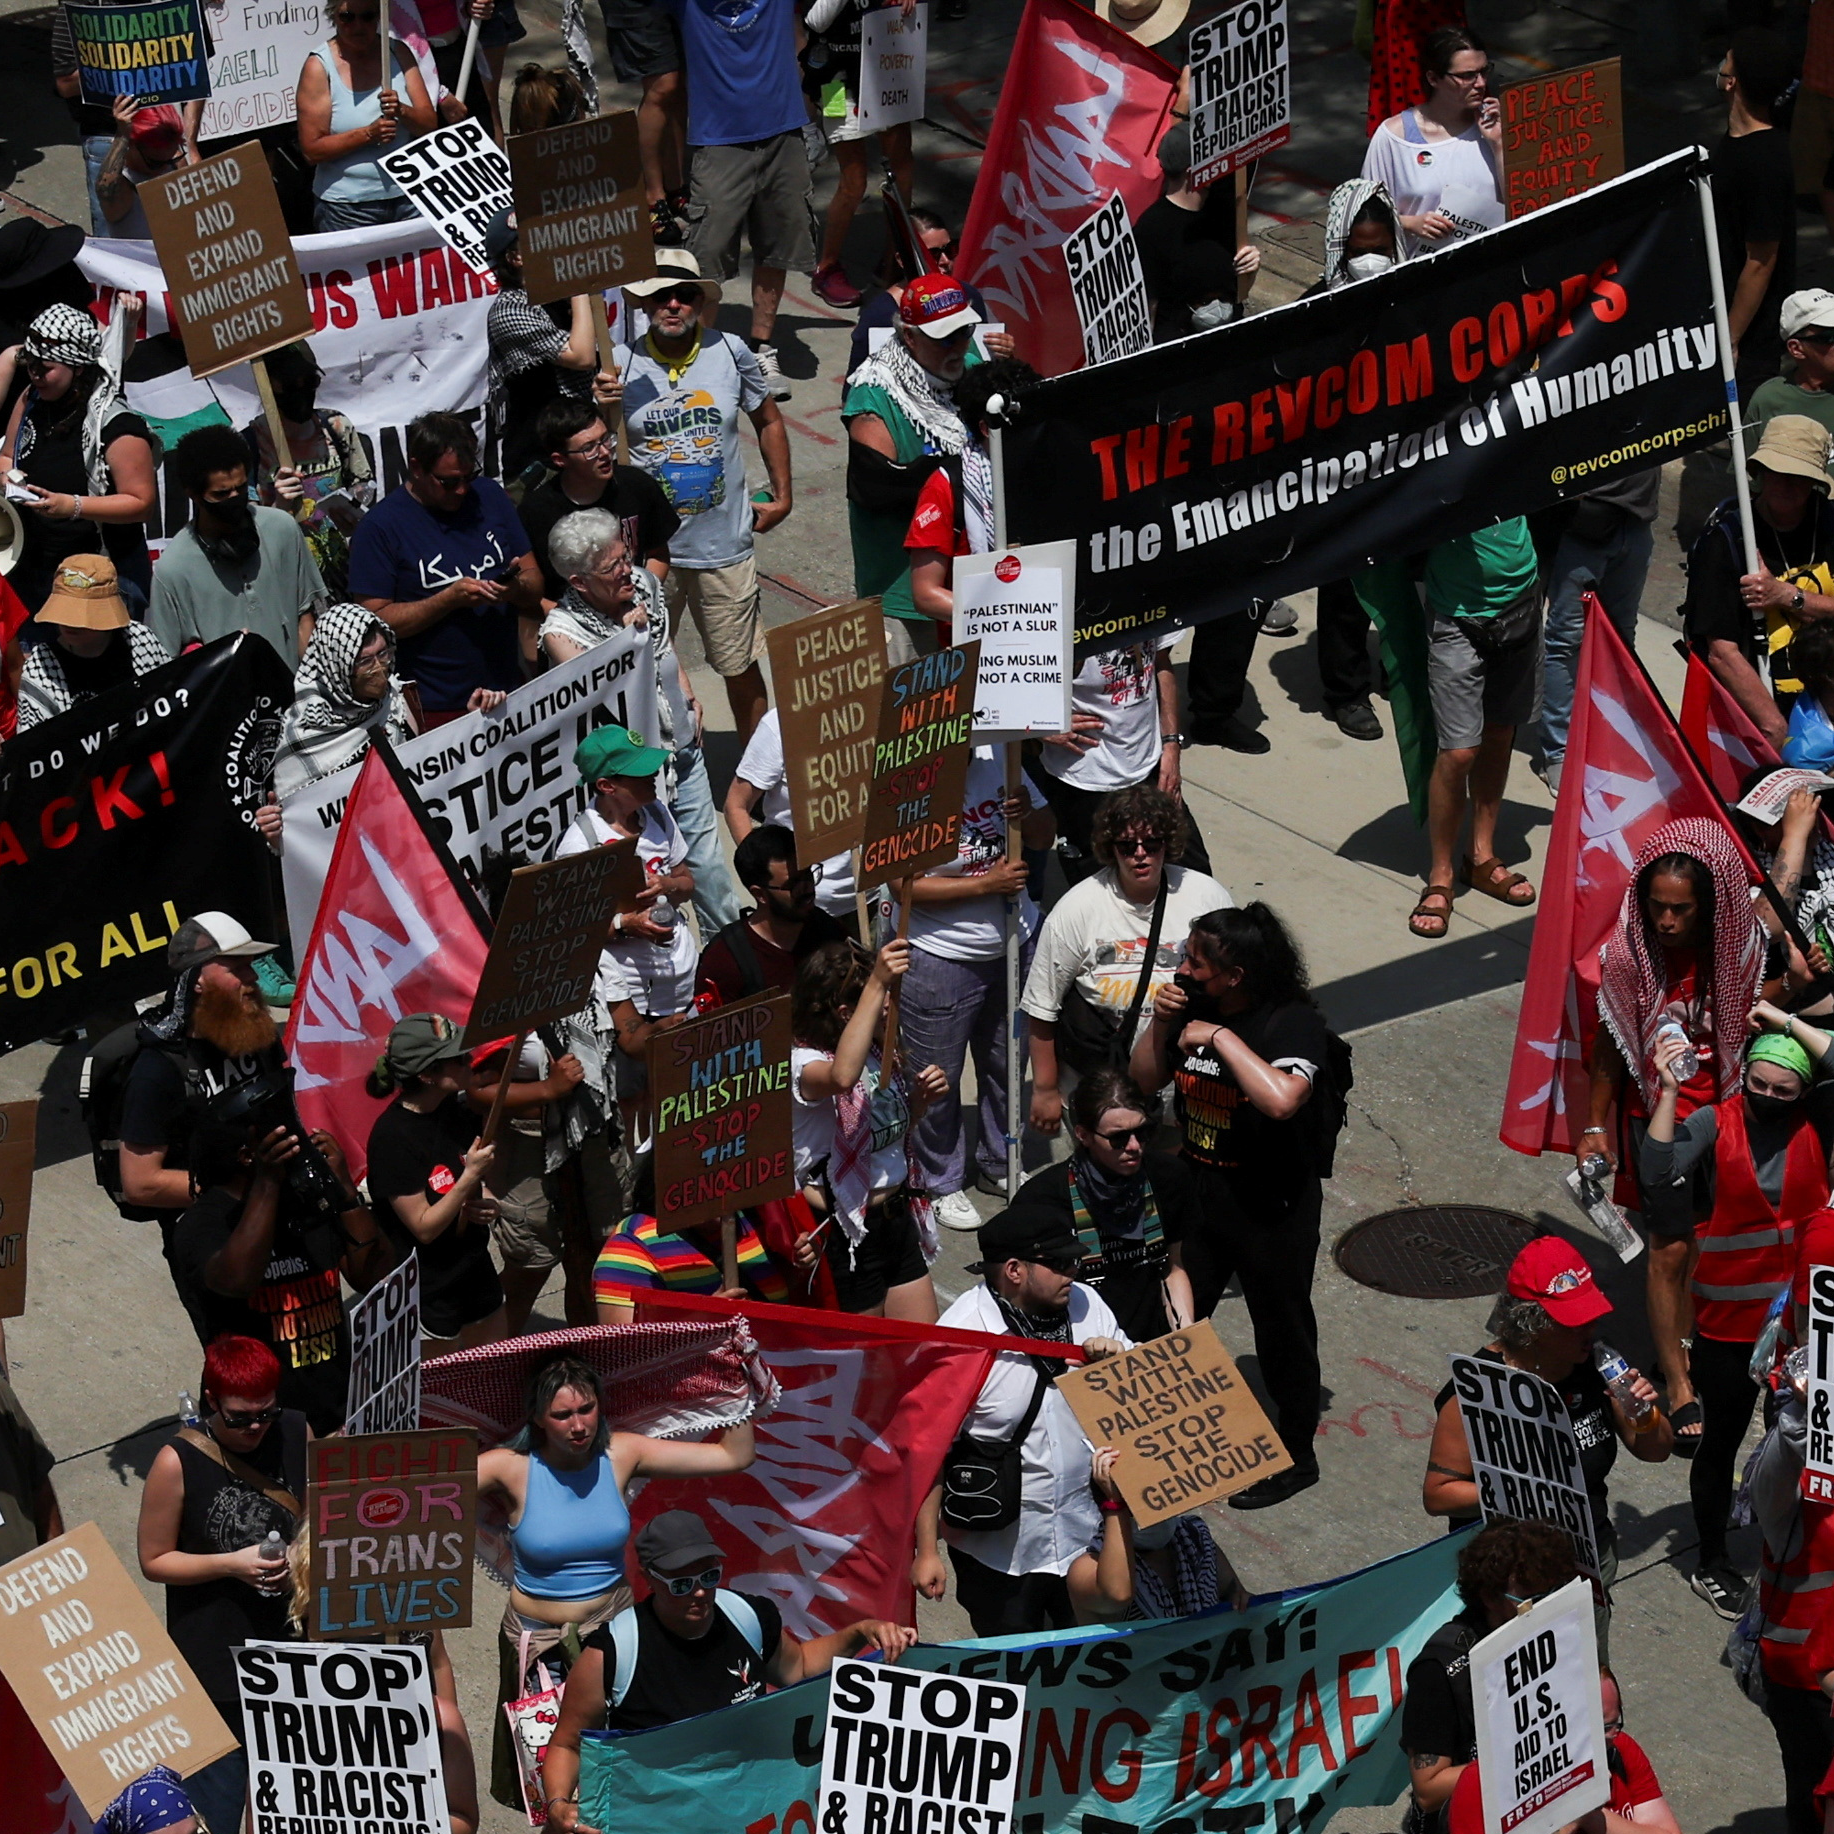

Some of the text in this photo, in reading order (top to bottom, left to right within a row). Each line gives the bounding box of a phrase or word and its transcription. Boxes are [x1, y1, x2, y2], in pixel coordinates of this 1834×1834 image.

[72, 4, 191, 43] SOLIDARITY
[887, 20, 904, 35] WAR
[78, 33, 196, 70] SOLIDARITY
[879, 54, 914, 70] POVERTY
[82, 59, 200, 98] SOLIDARITY
[881, 89, 908, 106] DEATH
[166, 159, 242, 211] DEFEND
[193, 205, 235, 241] AND
[188, 226, 265, 282] EXPAND
[182, 256, 291, 324] IMMIGRANT
[211, 299, 283, 351] RIGHTS
[1090, 259, 1626, 502] THE REVCOM CORPS
[643, 408, 722, 436] RIVERS
[646, 408, 680, 420] LET OUR
[684, 426, 706, 437] UNITE
[1090, 322, 1720, 575] the Emancipation Humanity
[1550, 408, 1729, 484] @revcomcorpschi
[967, 621, 1058, 635] IS NOT A SLUR
[979, 672, 1062, 684] NOT A CRIME
[1007, 655, 1057, 666] MUSLIM
[317, 1439, 467, 1488] FIGHT
[319, 1531, 463, 1580] TRANS
[317, 1578, 460, 1632] LIVES
[1504, 1629, 1557, 1698] END
[1513, 1682, 1561, 1735] U.S.
[1514, 1712, 1567, 1770] AID TO
[1514, 1743, 1573, 1800] ISRAEL
